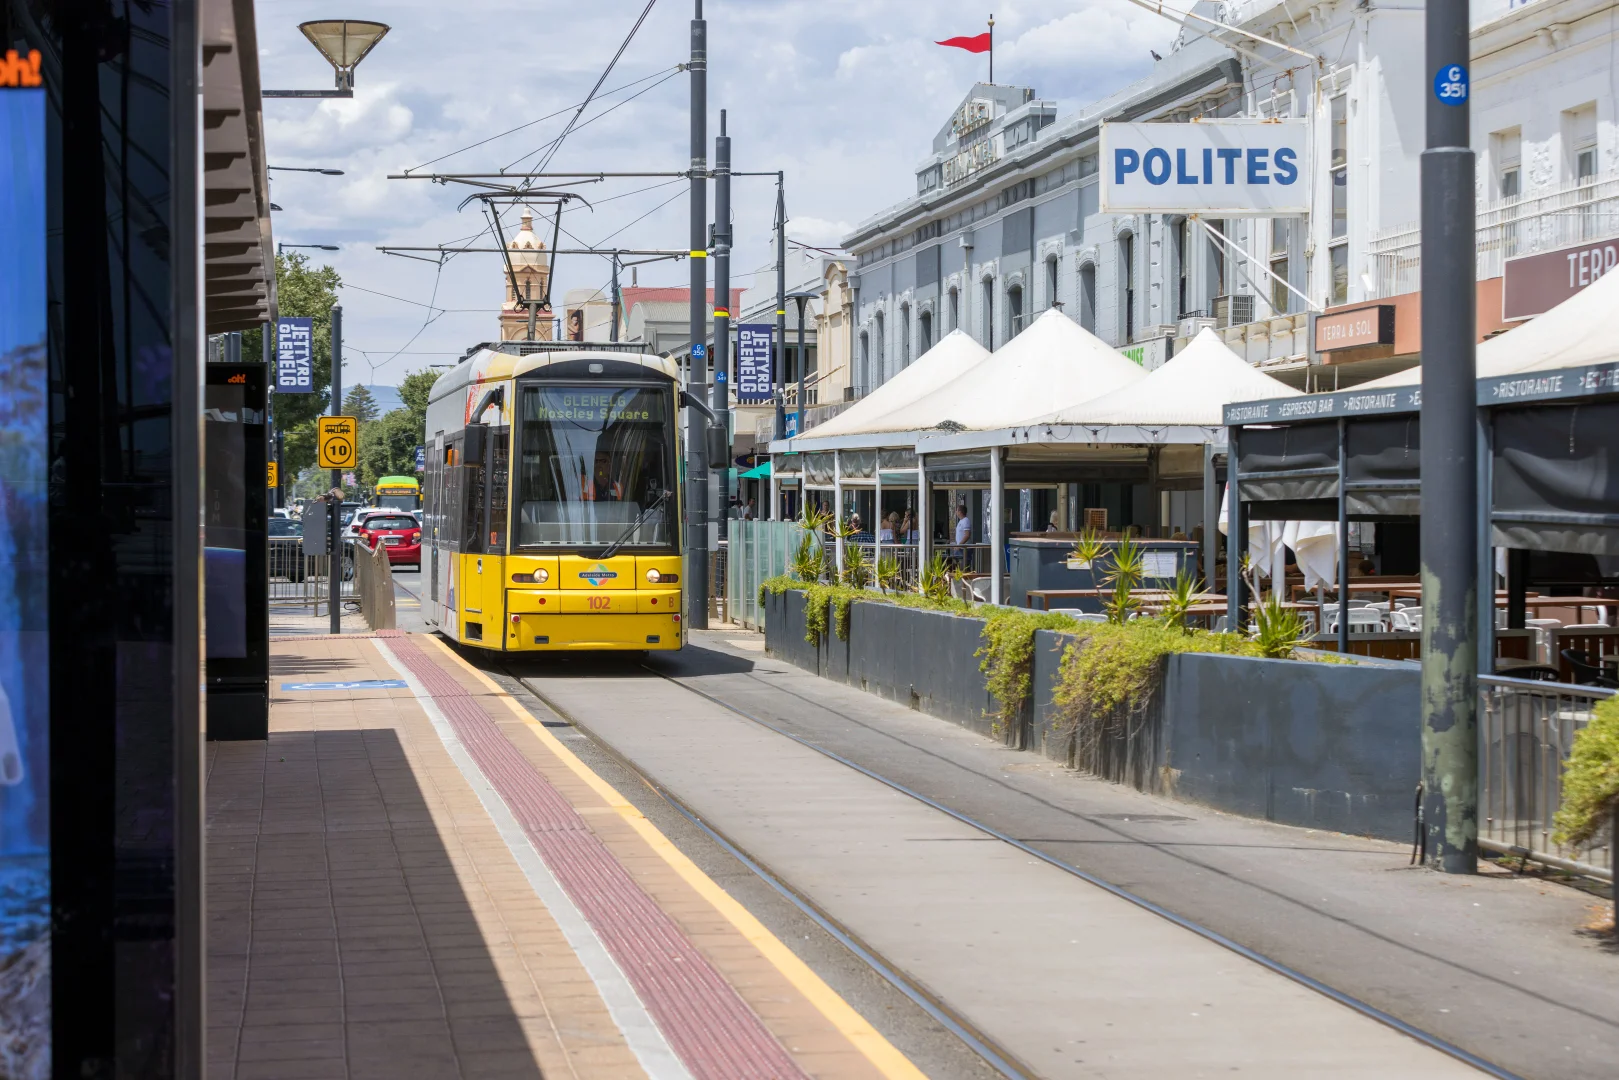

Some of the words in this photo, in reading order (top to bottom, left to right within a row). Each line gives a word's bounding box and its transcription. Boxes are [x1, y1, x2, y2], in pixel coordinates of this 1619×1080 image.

[1449, 66, 1460, 82] G
[1440, 82, 1466, 98] 351
[1114, 148, 1298, 186] POLITES
[1323, 324, 1346, 340] TERRA
[1348, 324, 1354, 337] &
[1356, 320, 1372, 336] SOL
[279, 324, 296, 386] GLENELG
[740, 330, 756, 392] GLENELG
[1498, 376, 1564, 398] RISTORANTE
[564, 396, 626, 407] GLENELG
[1282, 400, 1317, 416] ESPRESSO
[1318, 399, 1334, 413] BAR
[1348, 393, 1397, 410] RISTORANTE
[539, 406, 594, 419] Moseley
[600, 407, 649, 419] Square
[1230, 404, 1269, 420] RISTORANTE
[330, 446, 347, 456] 10
[587, 596, 611, 609] 102
[669, 597, 674, 607] B
